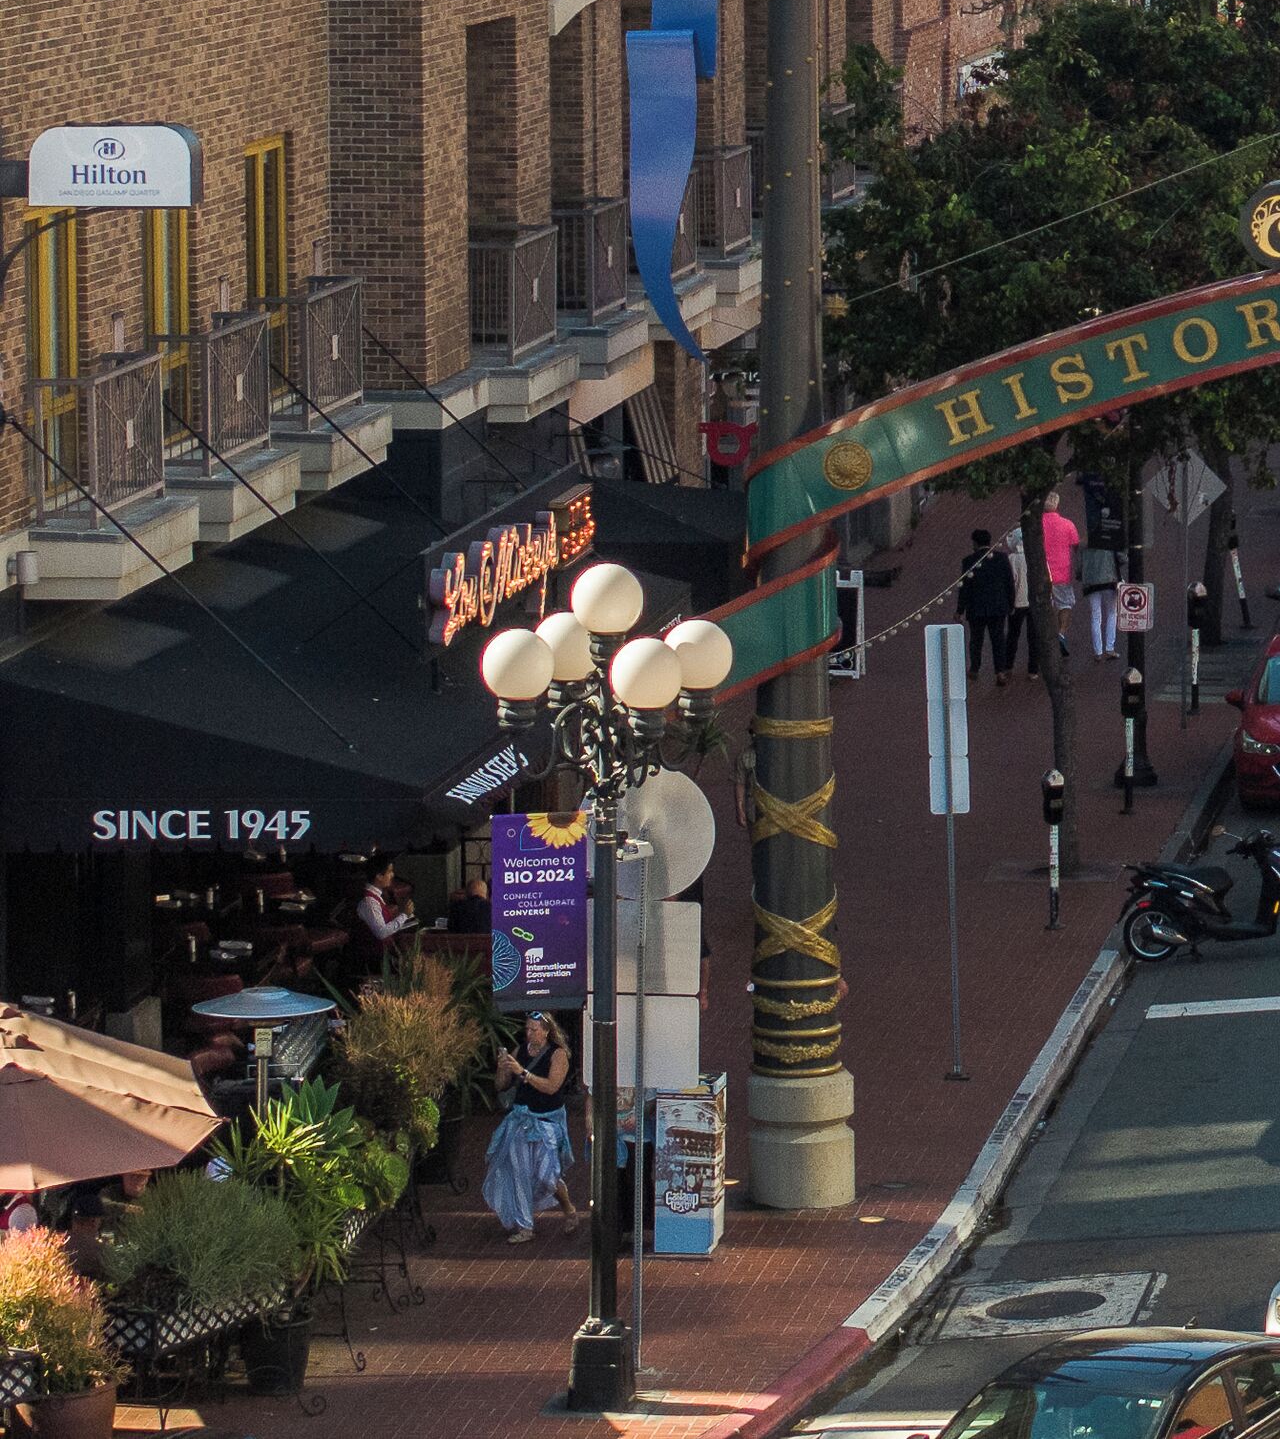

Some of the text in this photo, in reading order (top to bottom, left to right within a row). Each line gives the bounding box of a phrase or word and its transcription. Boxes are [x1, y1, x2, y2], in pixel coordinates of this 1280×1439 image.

[72, 164, 146, 184] Hilton
[445, 767, 502, 805] FAMOUS
[93, 809, 311, 840] SINCE 1945
[503, 856, 576, 868] Welcome to
[504, 869, 575, 884] BIO 2024
[503, 892, 543, 901] CONNECT
[518, 898, 576, 908] COLLABORATE
[503, 908, 550, 917] CONVERGE
[526, 962, 576, 971] International
[526, 970, 571, 978] Convention
